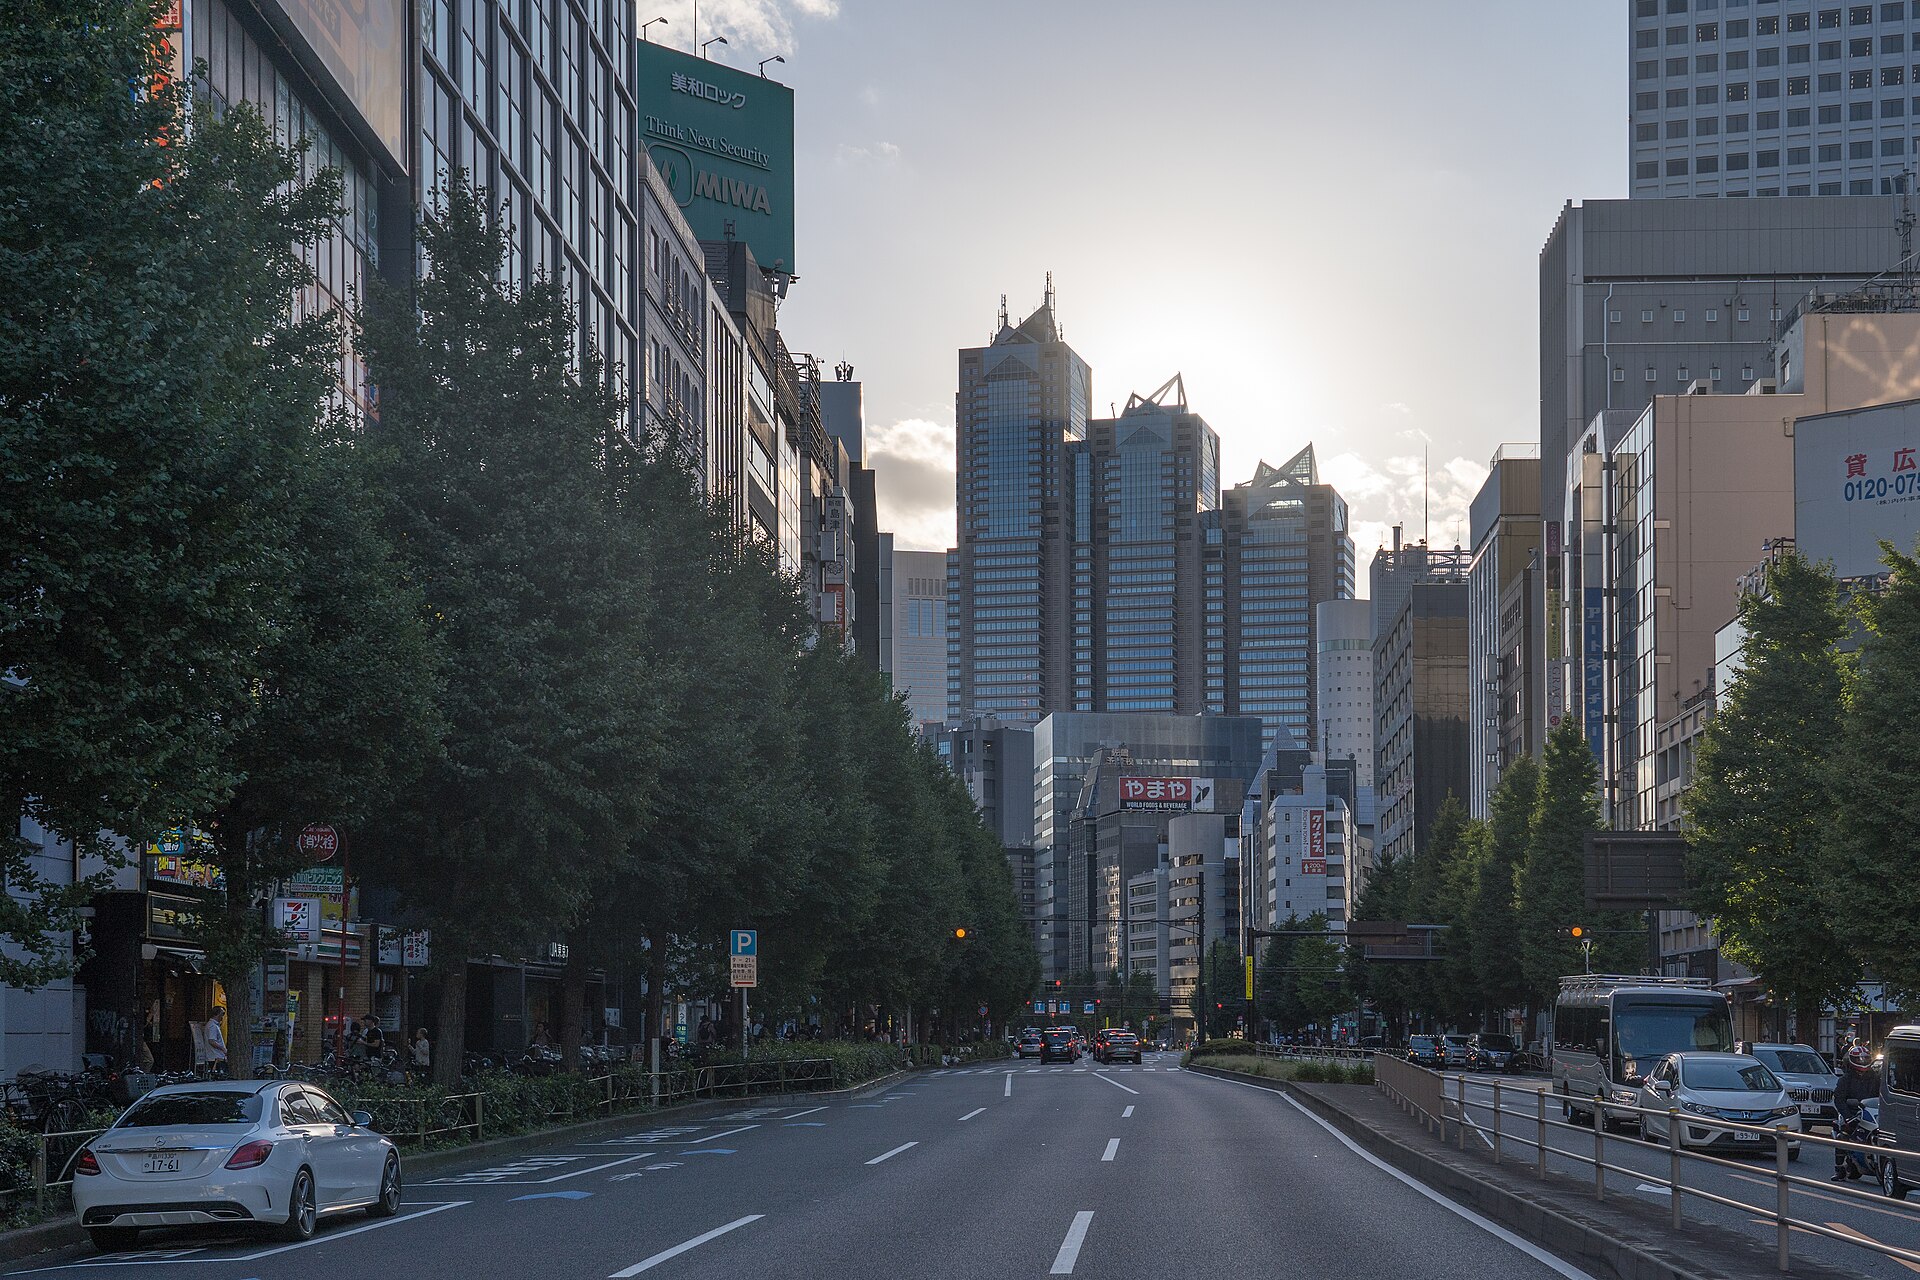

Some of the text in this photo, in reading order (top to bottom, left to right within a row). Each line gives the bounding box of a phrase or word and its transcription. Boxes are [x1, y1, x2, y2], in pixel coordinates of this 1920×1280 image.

[671, 71, 746, 109] 美和ロック
[645, 114, 770, 167] Think Next Security
[694, 169, 772, 216] MIWA
[1586, 606, 1602, 738] アートネイチャー
[1125, 780, 1187, 799] やまや
[1126, 801, 1142, 809] WORLD
[302, 834, 335, 850] 消火栓
[1311, 814, 1324, 853] クリナップ
[737, 932, 752, 953] P
[152, 1159, 179, 1171] 17-61
